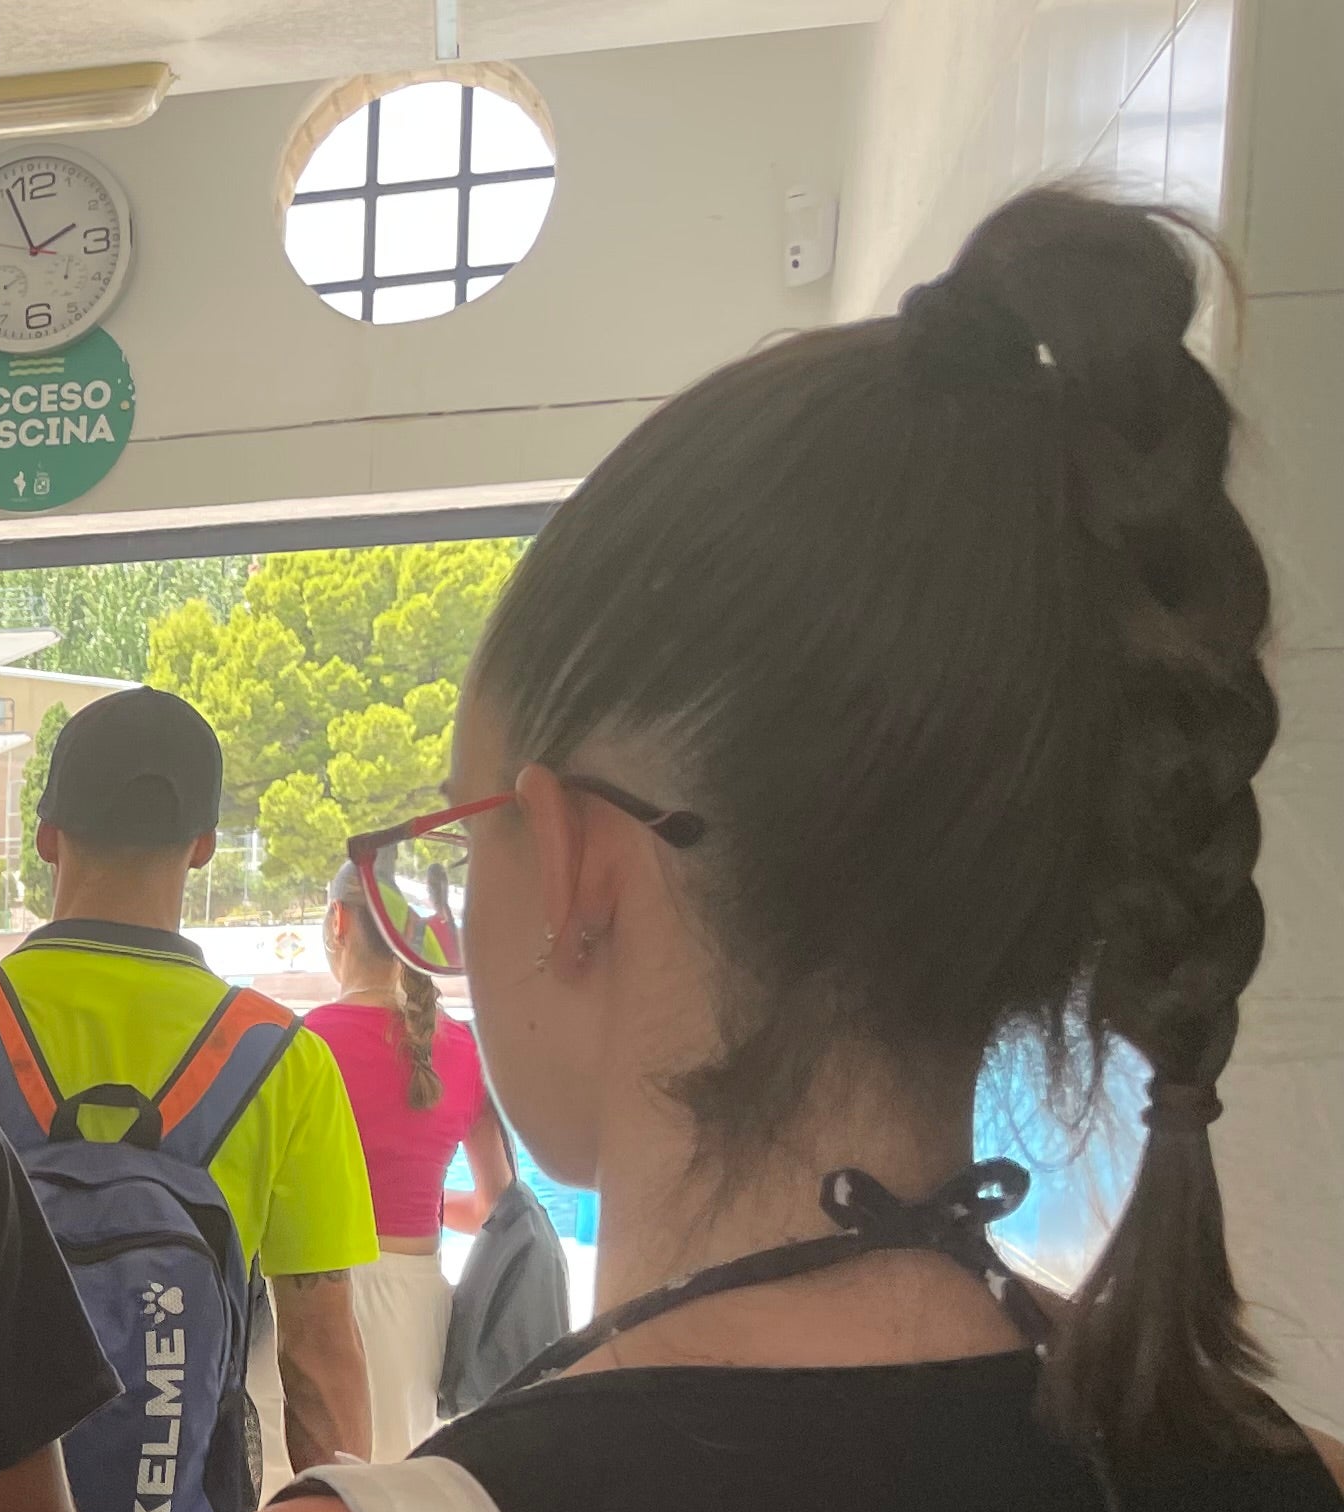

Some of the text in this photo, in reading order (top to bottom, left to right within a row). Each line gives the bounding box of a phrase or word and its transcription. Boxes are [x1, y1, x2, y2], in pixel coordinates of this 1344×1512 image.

[12, 172, 56, 201] 12
[88, 200, 98, 211] 2
[84, 227, 110, 254] 3
[91, 271, 102, 282] 4
[67, 302, 78, 314] 5
[0, 313, 8, 325] 7
[25, 303, 52, 329] 6
